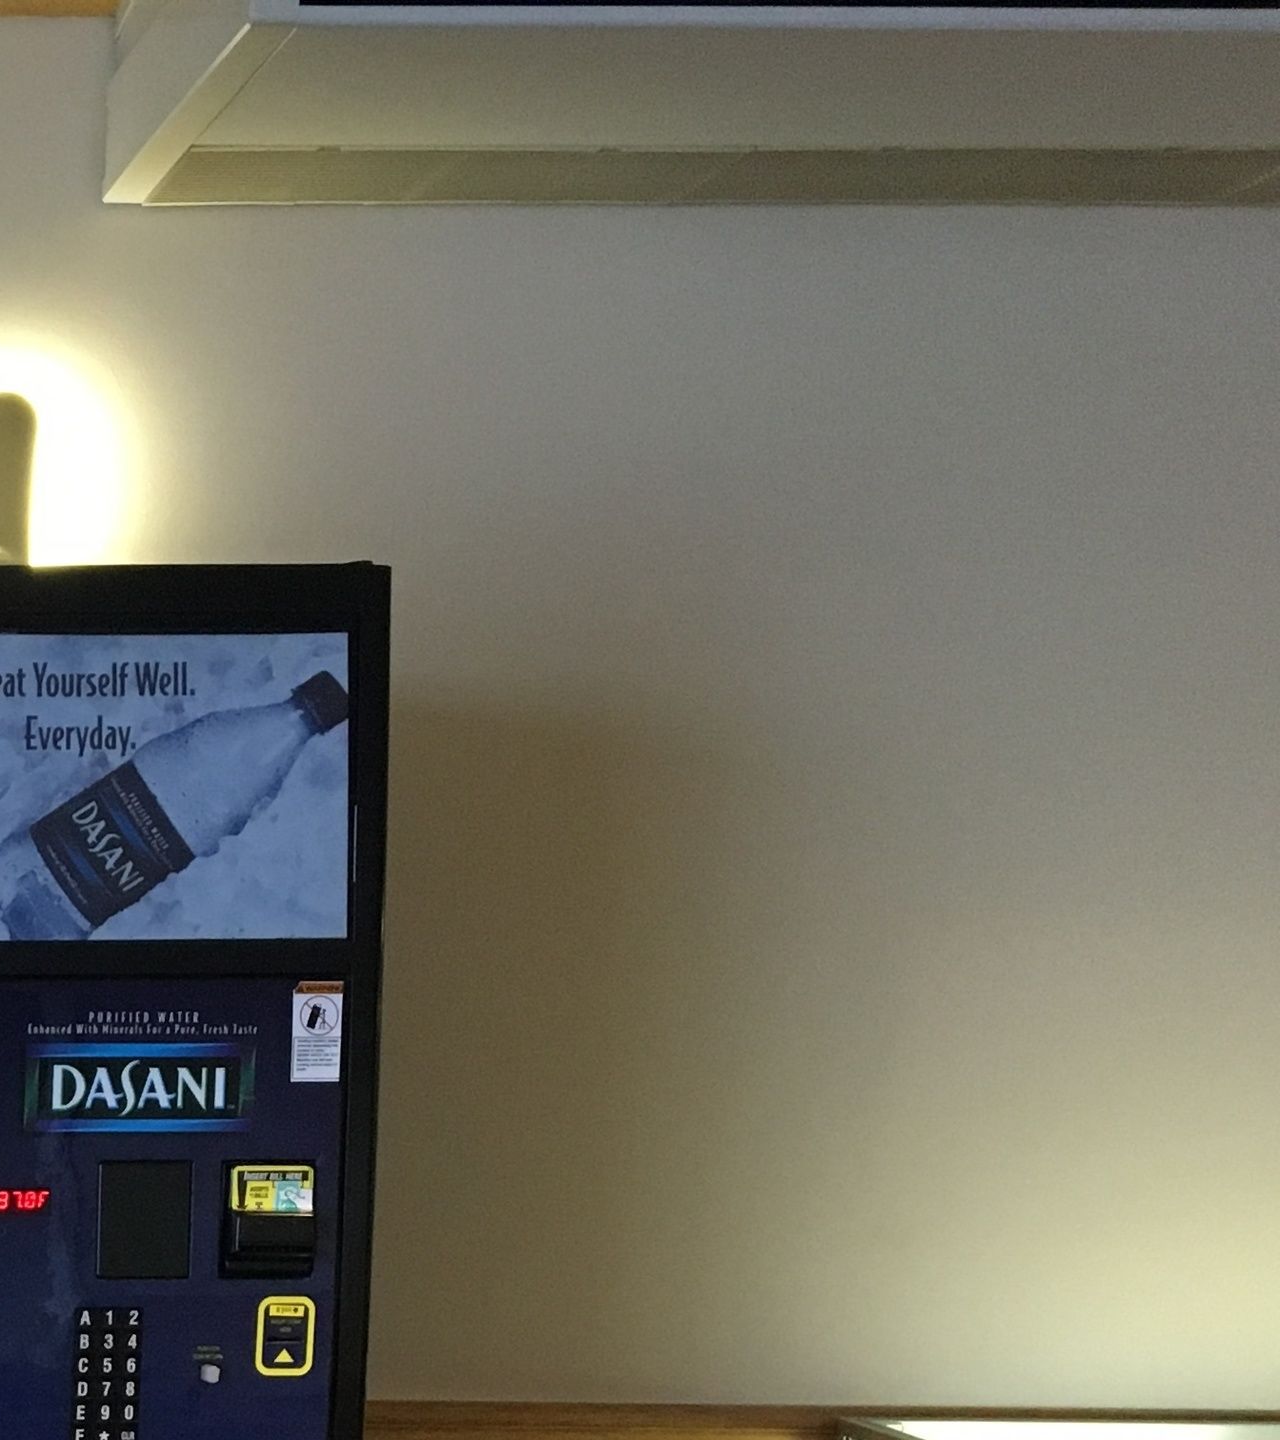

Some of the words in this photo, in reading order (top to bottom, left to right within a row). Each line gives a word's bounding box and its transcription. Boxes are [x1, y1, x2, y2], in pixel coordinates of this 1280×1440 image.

[32, 661, 129, 698] Yourself
[134, 661, 197, 698] Well.
[24, 714, 137, 757] Everyday.
[71, 800, 145, 892] DASANI
[88, 1010, 150, 1024] PURIFIED
[157, 1010, 200, 1024] WATER
[27, 1023, 73, 1035] Enhanced
[75, 1023, 99, 1035] With
[101, 1023, 143, 1035] Minerals
[146, 1023, 162, 1035] For
[165, 1025, 171, 1035] a
[203, 1023, 229, 1035] Fresh
[232, 1023, 258, 1036] Taste
[51, 1059, 226, 1117] DASANI
[80, 1310, 91, 1326] A
[105, 1310, 113, 1326] 1
[128, 1310, 139, 1326] 2
[80, 1333, 89, 1350] B
[103, 1333, 113, 1350] 3
[127, 1333, 137, 1350] 4
[78, 1357, 88, 1373] C
[102, 1357, 112, 1373] 5
[126, 1357, 136, 1373] 6
[77, 1381, 88, 1397] D
[101, 1381, 111, 1397] 7
[125, 1381, 135, 1397] 8
[76, 1404, 86, 1420] E
[100, 1404, 110, 1420] 9
[124, 1404, 134, 1420] 0
